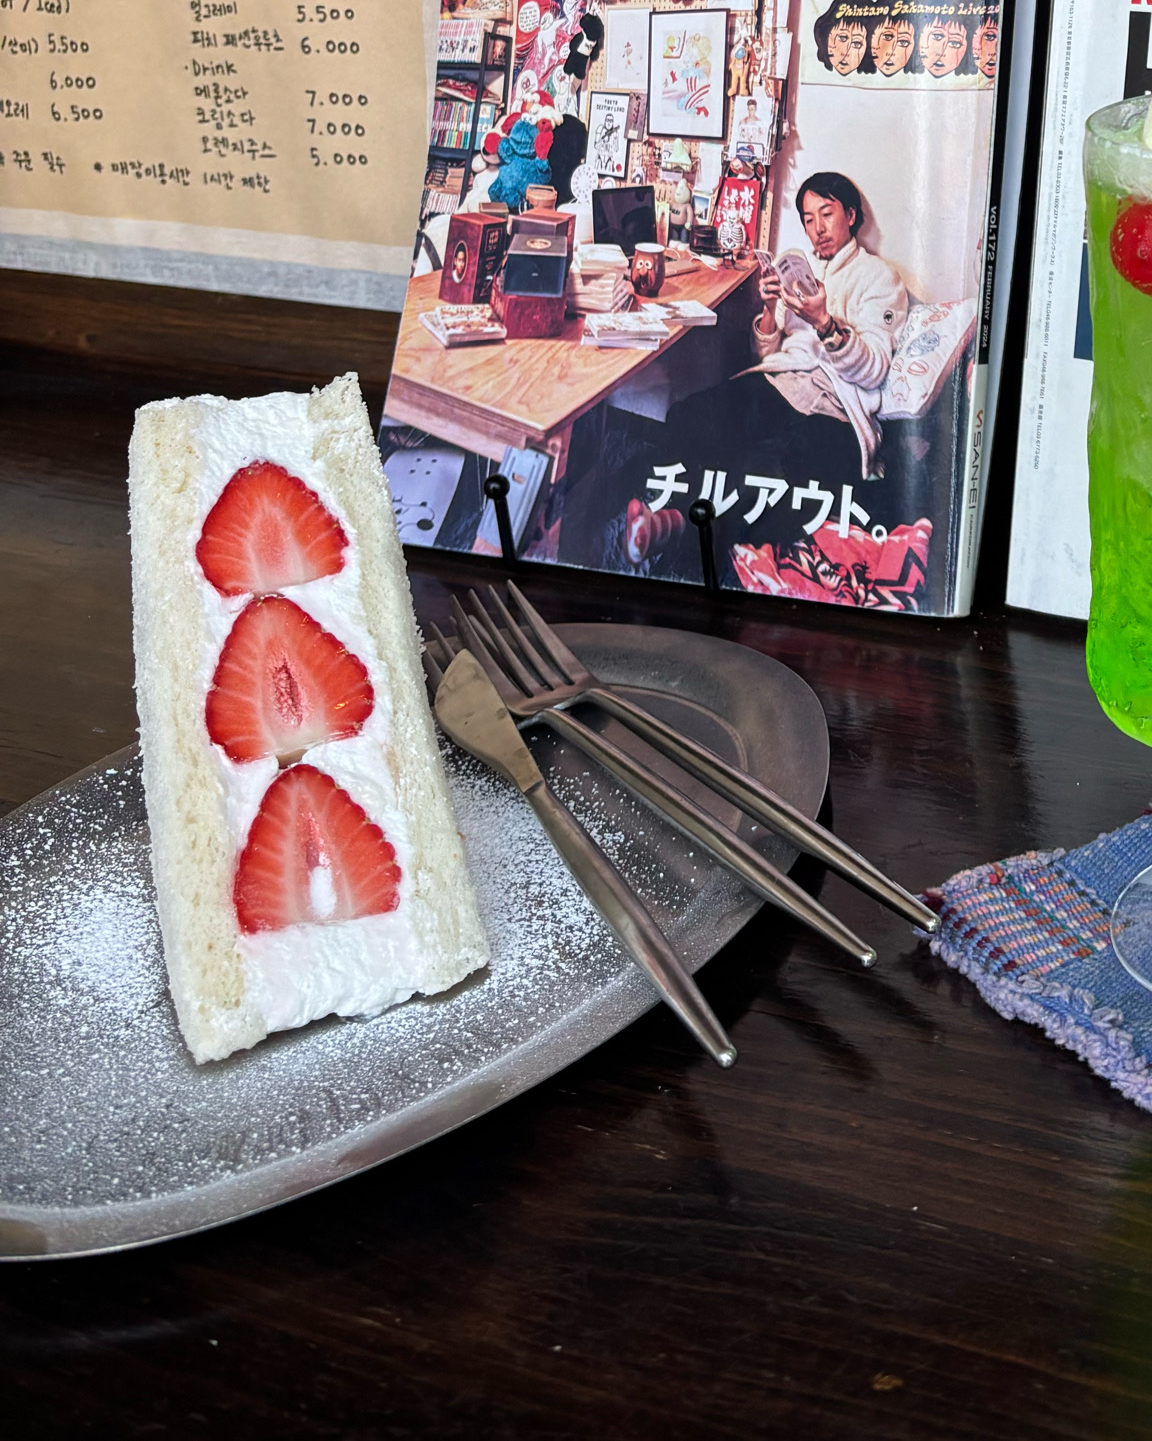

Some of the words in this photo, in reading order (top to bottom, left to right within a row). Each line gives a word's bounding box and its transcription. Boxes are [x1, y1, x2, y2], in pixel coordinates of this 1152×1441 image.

[190, 0, 238, 22] 얼그레이
[296, 5, 355, 23] 5.500
[890, 0, 955, 16] Sakamoto
[48, 33, 90, 54] 5.500
[300, 36, 360, 55] 6.000
[192, 59, 238, 76] Drink
[49, 71, 96, 90] 6.000
[194, 83, 249, 107] 메론소다
[305, 90, 369, 107] 7.000
[0, 99, 29, 120] 오레
[51, 103, 103, 122] 6.500
[196, 108, 256, 131] 크림소다
[306, 118, 366, 137] 7.000
[13, 150, 33, 172] 주문
[41, 151, 66, 174] 필수
[201, 136, 277, 160] 오렌지주스
[309, 147, 368, 167] 5.000
[202, 170, 235, 190] 1시간
[241, 172, 271, 194] 제한
[987, 205, 998, 261] vol.172
[968, 431, 981, 509] SAN-EI
[646, 462, 888, 544] チルアウト。
